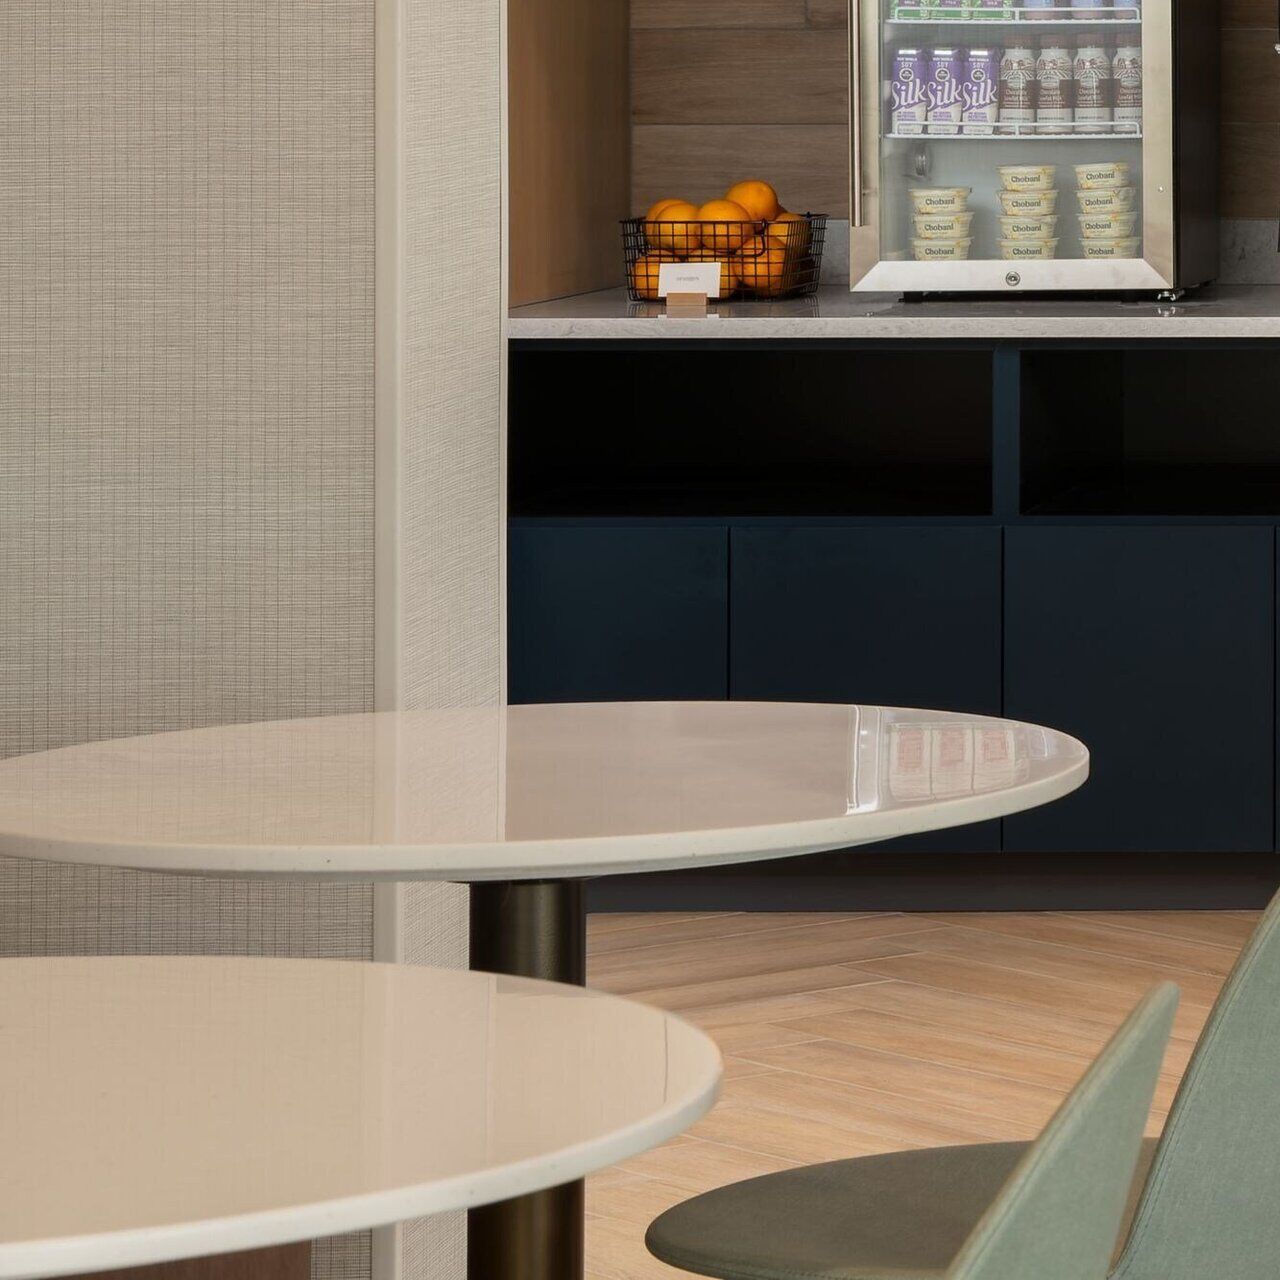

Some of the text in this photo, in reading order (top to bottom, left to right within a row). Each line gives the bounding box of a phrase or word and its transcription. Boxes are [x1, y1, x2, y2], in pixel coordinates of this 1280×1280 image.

[892, 79, 926, 110] Silk
[927, 78, 962, 110] Silk
[962, 79, 998, 111] Silk
[1011, 175, 1041, 183] Chobani
[1086, 172, 1115, 180] Chobani
[925, 198, 955, 206] Chobani
[1011, 200, 1042, 208] Chobani
[1085, 198, 1113, 206] Chobani
[924, 223, 954, 231] Chobani
[1012, 225, 1042, 233] Chobani
[1085, 222, 1112, 230] Chobani
[925, 248, 955, 256] Chobani
[1012, 248, 1042, 256] Chobani
[1088, 248, 1115, 256] Chobani
